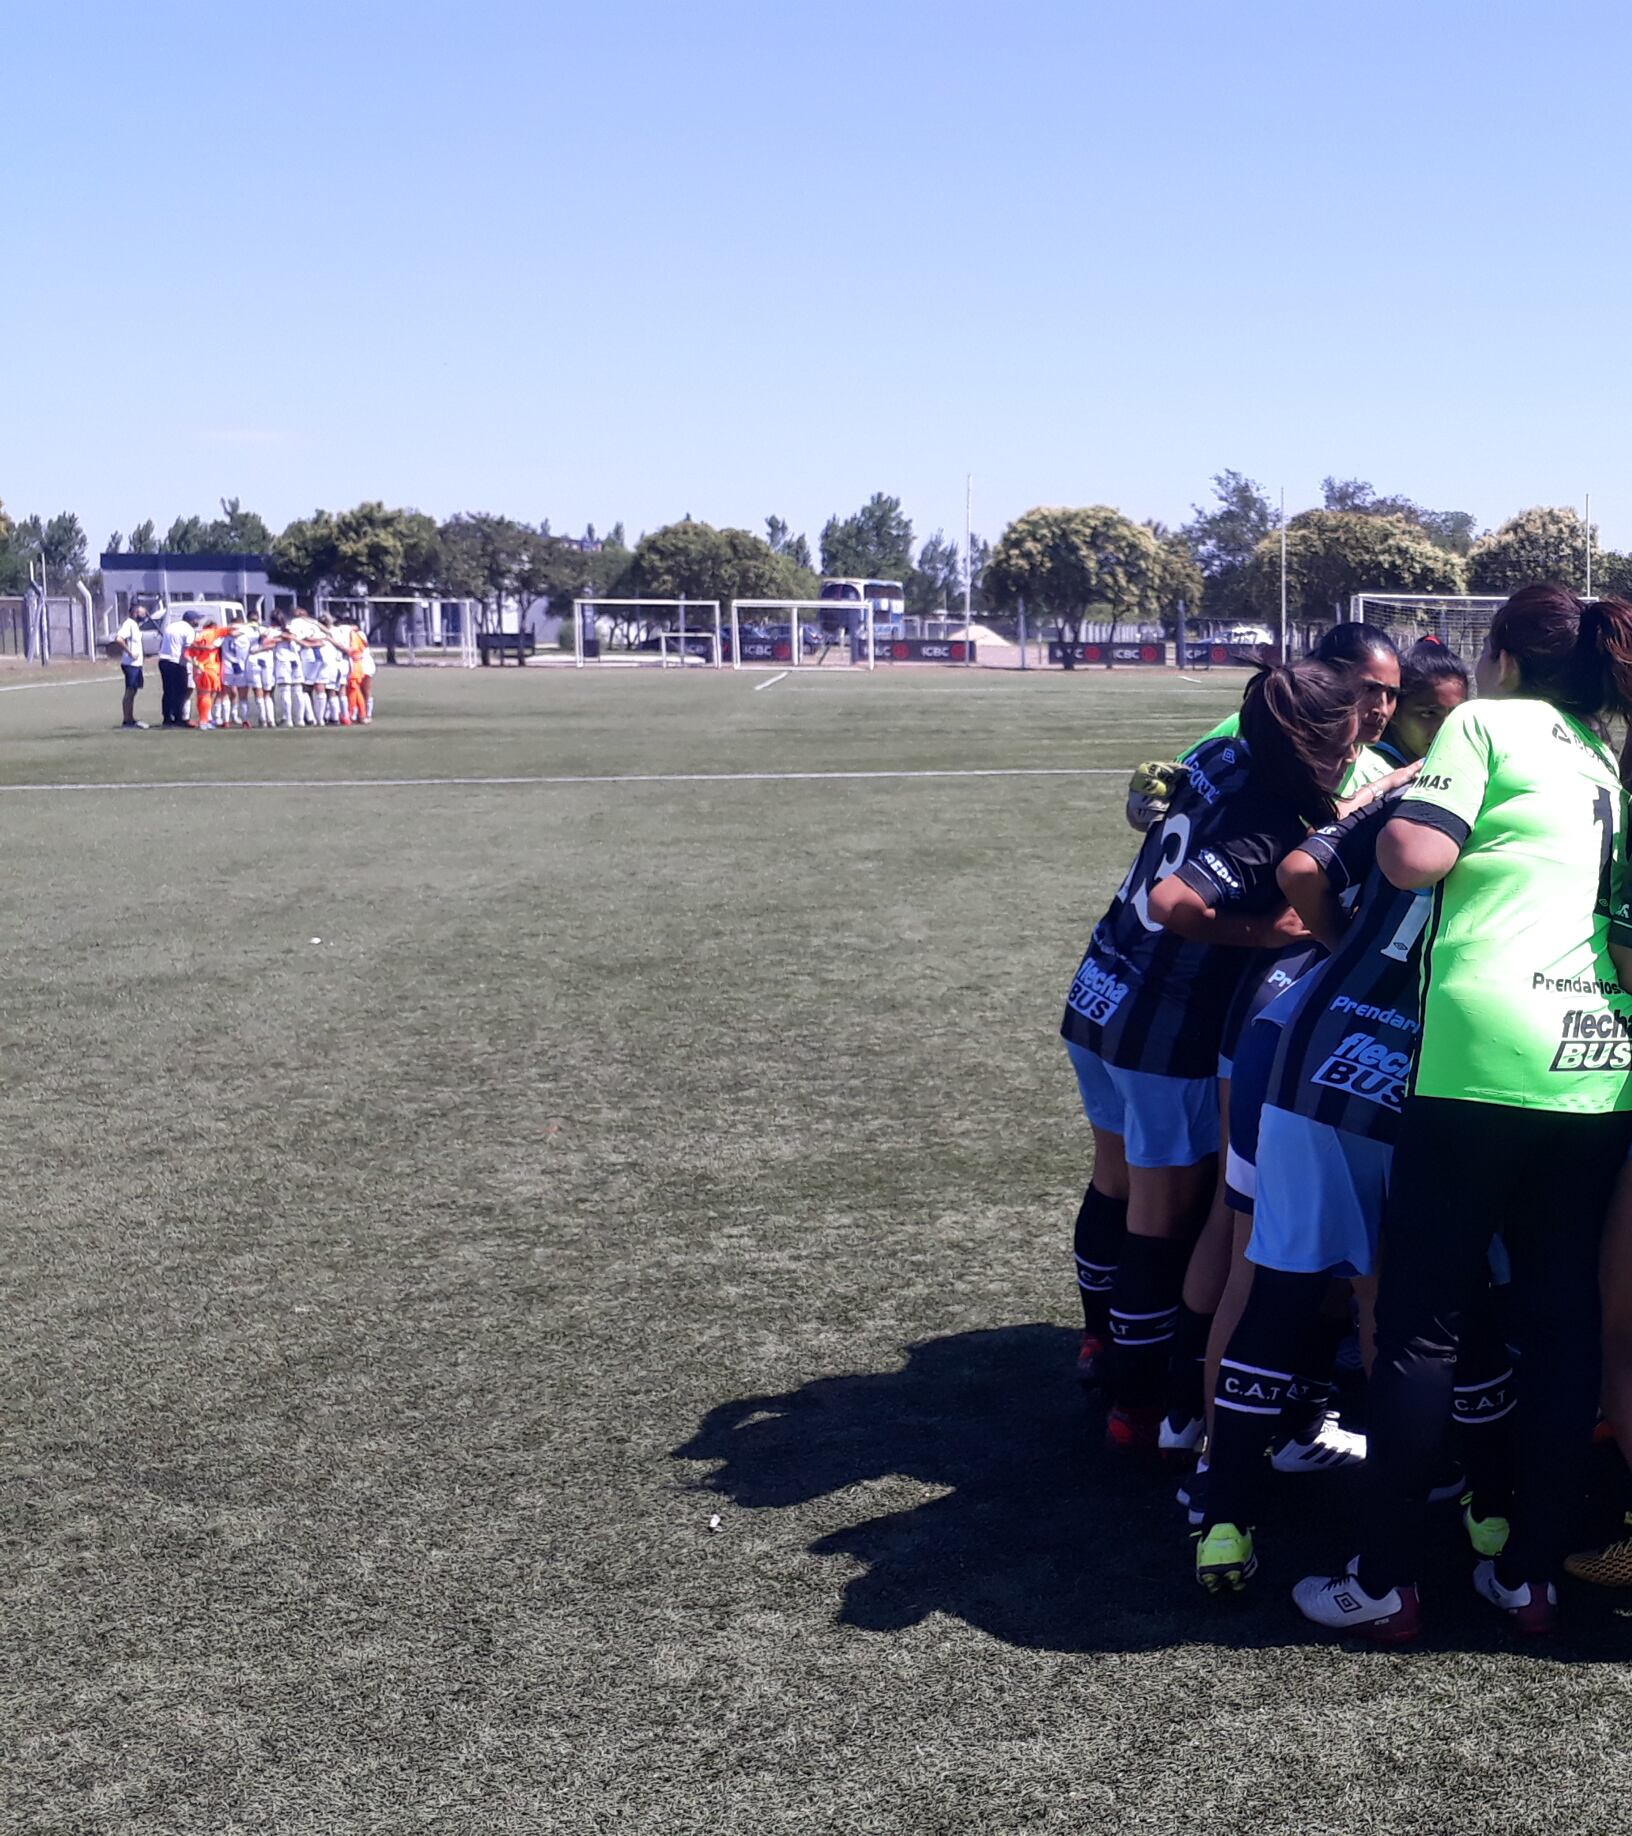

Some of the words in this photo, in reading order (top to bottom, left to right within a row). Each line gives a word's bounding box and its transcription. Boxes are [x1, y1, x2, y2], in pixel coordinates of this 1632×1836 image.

[744, 644, 773, 657] ICBC
[921, 645, 950, 658] ICBC
[1112, 649, 1141, 661] ICBC
[1076, 956, 1129, 1004] flecha
[1068, 980, 1112, 1022] BUS
